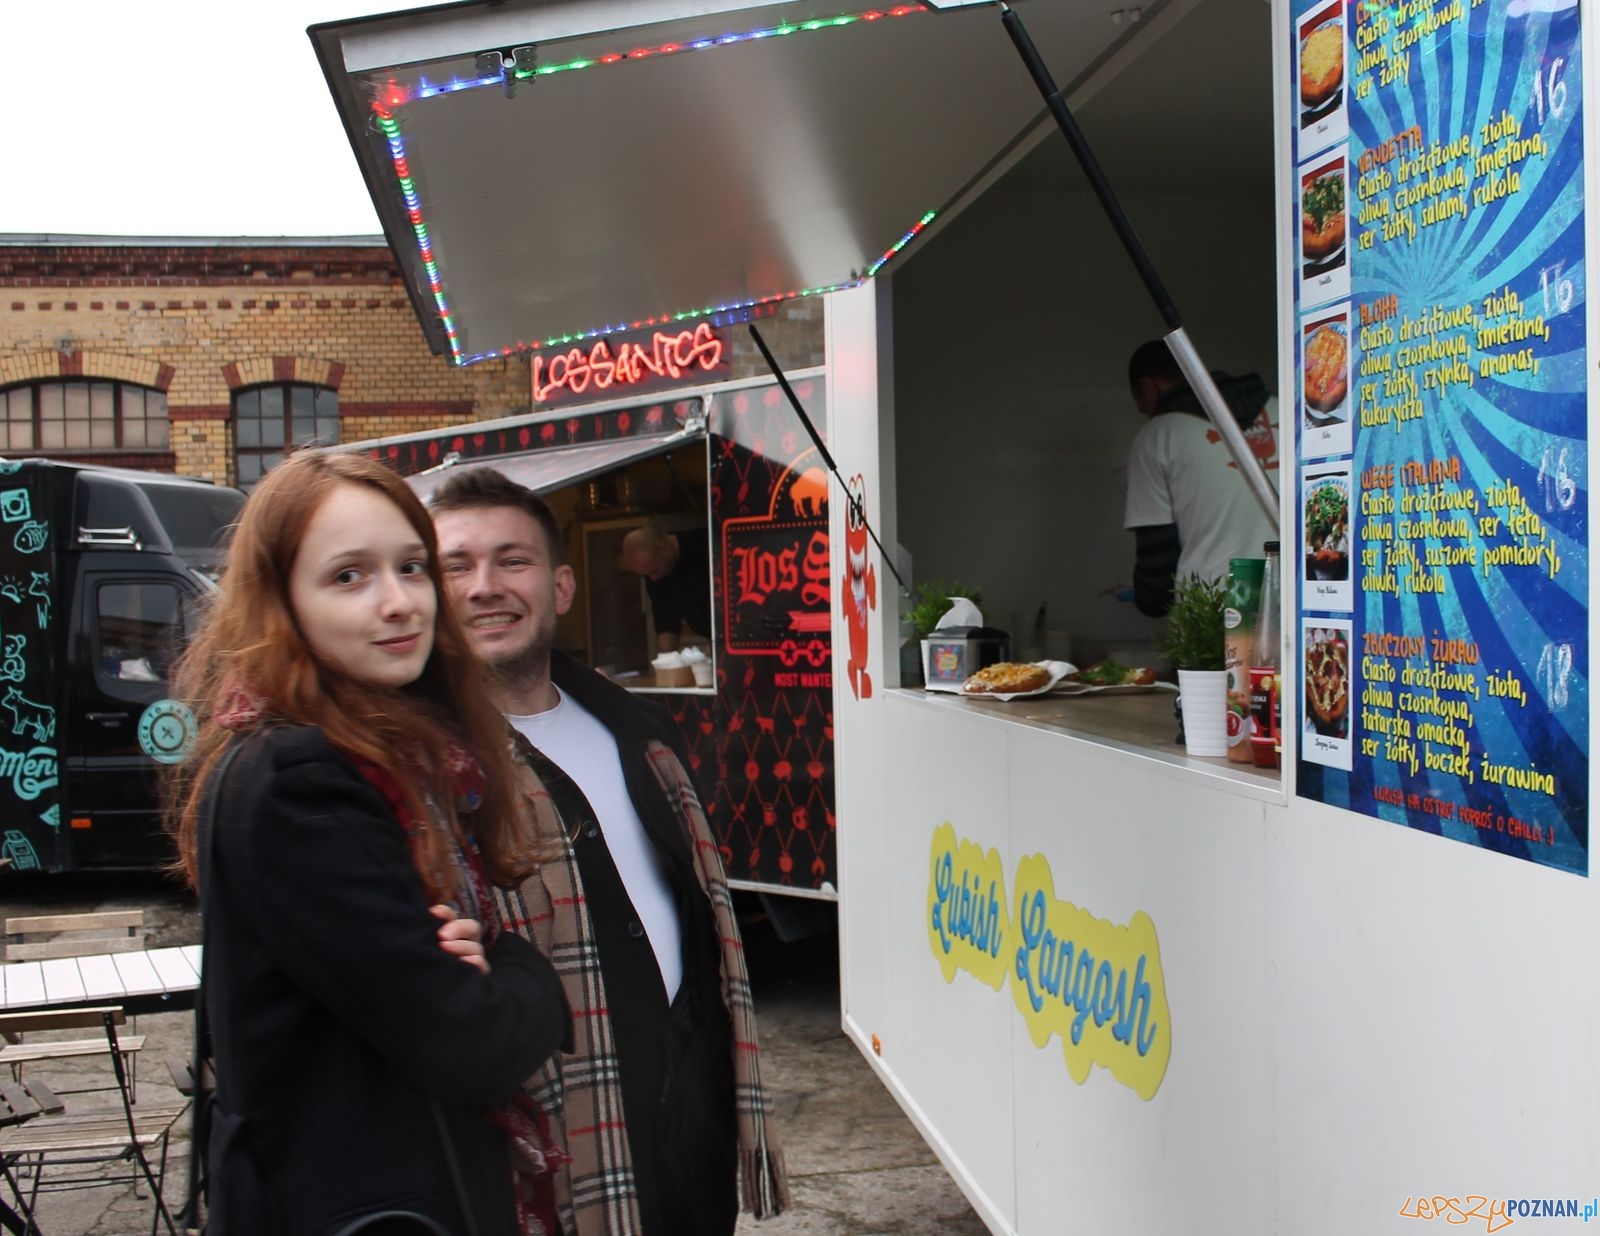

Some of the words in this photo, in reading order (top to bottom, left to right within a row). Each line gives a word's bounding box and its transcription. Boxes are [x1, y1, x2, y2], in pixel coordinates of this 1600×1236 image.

[1356, 16, 1390, 50] Ciasto
[1356, 44, 1387, 76] oliwa
[1356, 76, 1374, 101] ser
[1529, 57, 1567, 125] 16
[1358, 125, 1422, 174] VENDETTA
[1358, 166, 1391, 200] Ciasto
[1397, 135, 1475, 184] drożdżowe,
[1481, 109, 1521, 146] zioła,
[1358, 197, 1389, 226] oliwa
[1394, 166, 1469, 211] czosnkowa,
[1358, 229, 1377, 251] ser
[1422, 194, 1468, 228] salami,
[1473, 166, 1520, 208] rukola
[1360, 294, 1398, 326] ALOHA
[1361, 320, 1394, 351] Ciasto
[1400, 303, 1477, 342] drożdżowe,
[1483, 286, 1524, 319] zioła,
[1361, 351, 1391, 377] oliwa
[1397, 332, 1471, 368] czosnkowa,
[1361, 383, 1378, 402] ser
[1423, 356, 1474, 399] szynka,
[1480, 347, 1538, 378] ananas,
[1360, 395, 1423, 433] kukurydza
[1361, 464, 1395, 489] WEGE
[1401, 456, 1461, 487] ITALIANA
[1537, 447, 1576, 512] 16
[1361, 489, 1395, 515] Ciasto
[1400, 483, 1478, 514] drożdżowe,
[1485, 478, 1525, 513] zioła,
[1361, 516, 1392, 541] oliwa
[1398, 510, 1472, 546] czosnkowa,
[1479, 516, 1500, 537] ser
[1507, 505, 1546, 542] feta,
[1361, 548, 1379, 567] ser
[1425, 544, 1477, 567] suszone
[1484, 536, 1561, 580] pomidory,
[1361, 566, 1399, 599] oliwki,
[1404, 564, 1445, 594] rukola
[1362, 632, 1425, 660] ZBOCZONY
[1431, 629, 1480, 664] ŻURAW
[774, 672, 799, 688] MOST
[800, 672, 833, 688] WANTE
[1362, 656, 1397, 682] Ciasto
[1401, 660, 1480, 700] drożdżowe,
[1486, 669, 1527, 707] zioła,
[1536, 641, 1573, 713] 18
[1361, 706, 1411, 737] tatarska
[1362, 682, 1393, 709] oliwa
[1399, 688, 1473, 729] czosnkowa,
[1361, 738, 1380, 757] ser
[1385, 734, 1420, 777] żółty,
[1425, 742, 1474, 785] boczek,
[1481, 753, 1556, 796] żurawina
[1496, 815, 1505, 833] O
[932, 851, 1002, 959] Lubish
[1015, 889, 1157, 1057] Langosh
